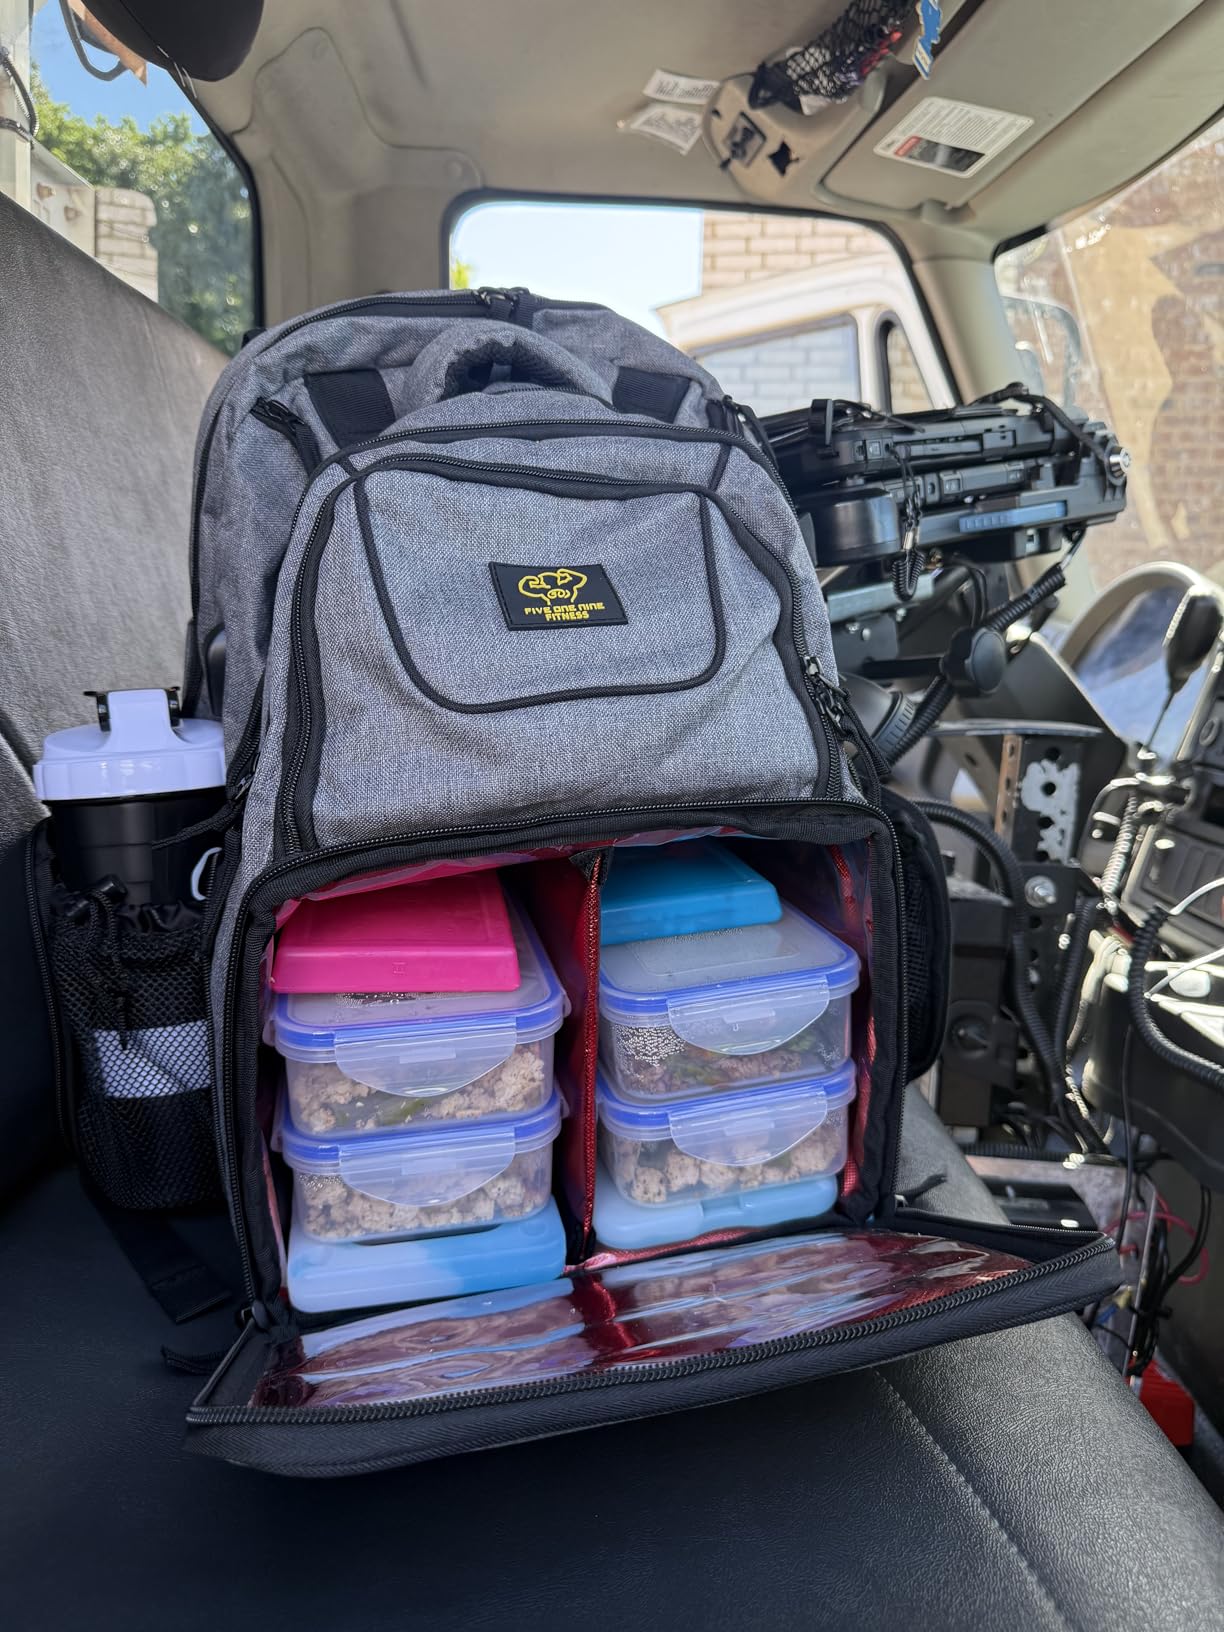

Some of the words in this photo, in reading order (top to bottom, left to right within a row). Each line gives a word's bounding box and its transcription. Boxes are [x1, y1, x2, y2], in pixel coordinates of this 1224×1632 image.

[524, 606, 552, 615] FIVE
[552, 604, 577, 613] ONE
[577, 602, 605, 611] NINE
[545, 611, 589, 621] FITNESS
